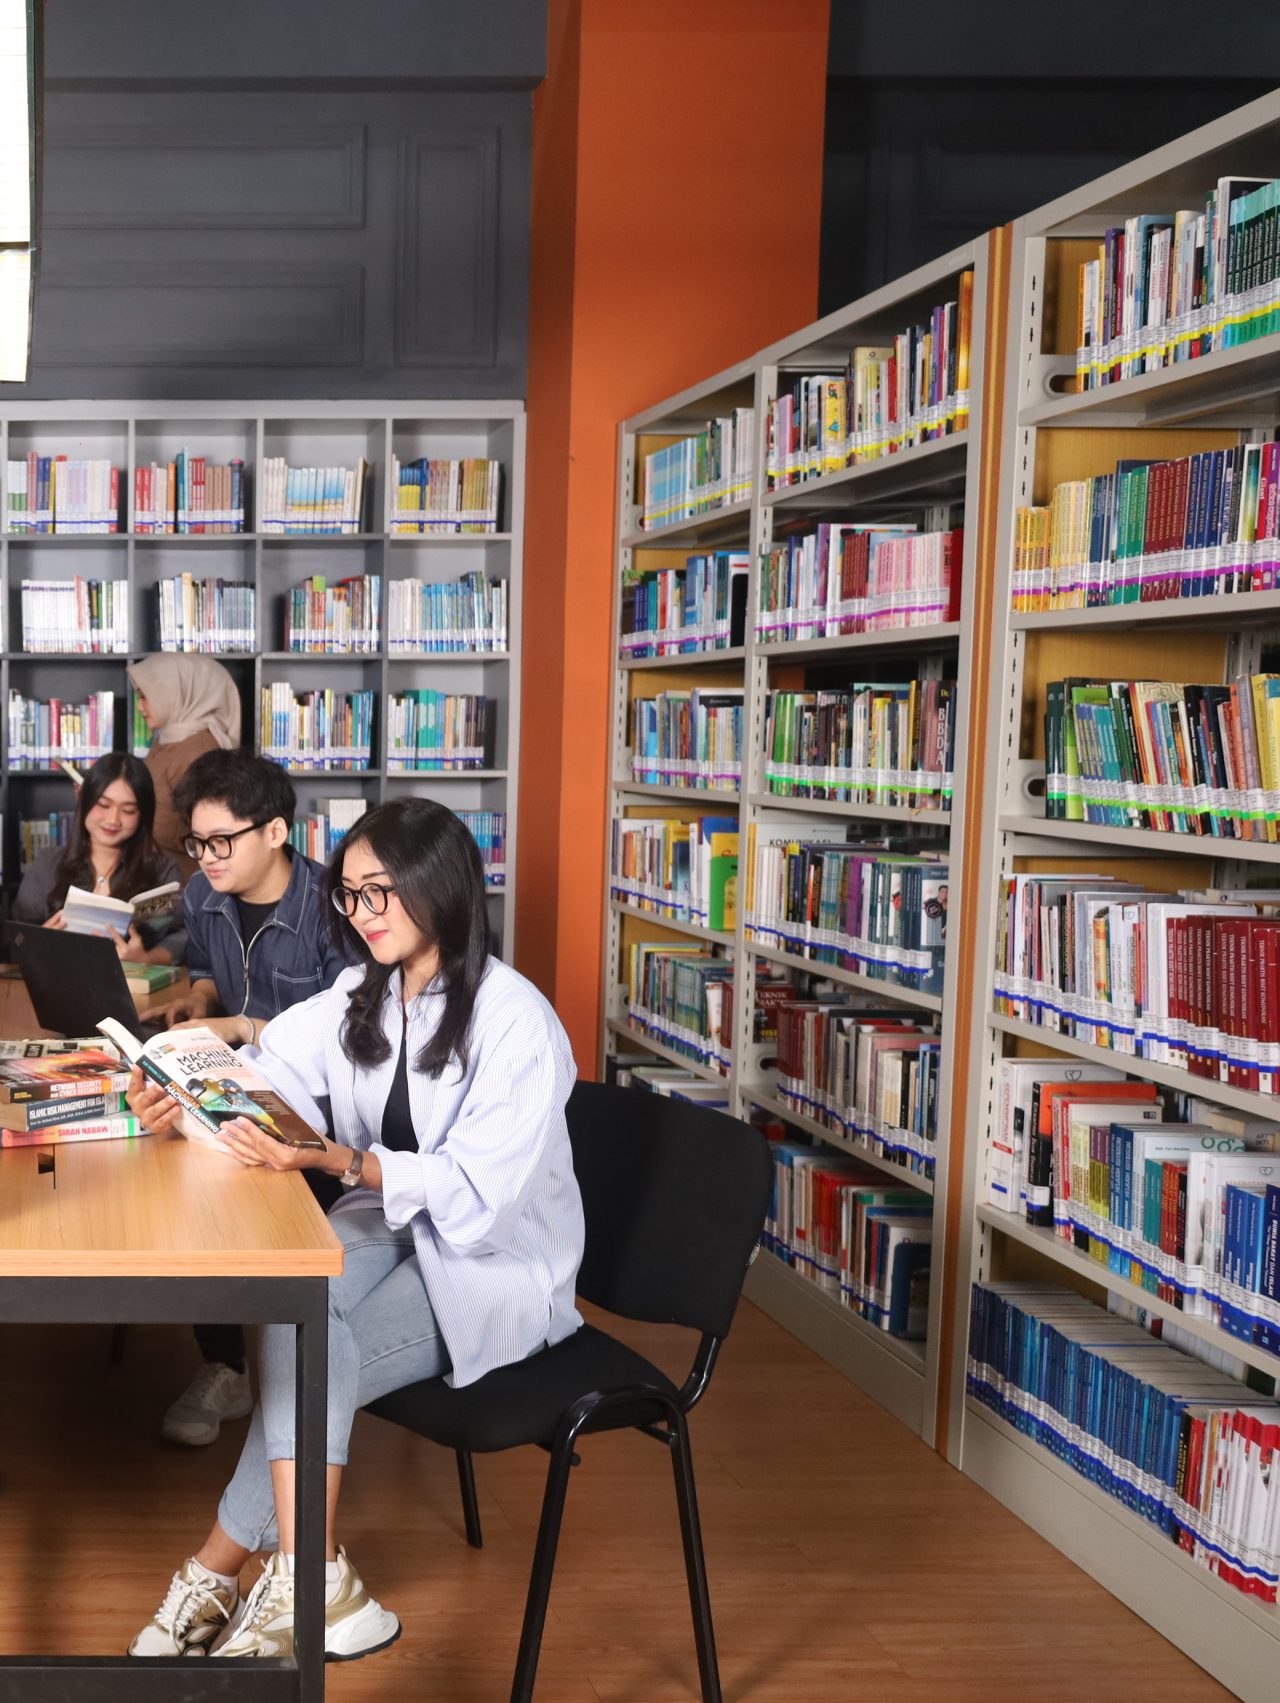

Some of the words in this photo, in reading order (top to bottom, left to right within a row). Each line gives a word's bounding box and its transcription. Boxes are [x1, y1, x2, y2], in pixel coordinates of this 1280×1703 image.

[176, 1050, 236, 1067] MACHINE
[180, 1058, 243, 1076] LEARNING
[50, 1082, 76, 1092] NETWORK
[77, 1080, 102, 1089] SECURITY
[59, 1089, 76, 1098] CYBER
[77, 1087, 102, 1096] SECURITY
[29, 1107, 47, 1119] ISLAMIC
[46, 1105, 58, 1116] RISK
[57, 1099, 87, 1114] MANAGEMENT
[87, 1098, 96, 1107] FOR
[164, 1085, 192, 1112] MACHINE
[188, 1105, 220, 1134] LEARNING
